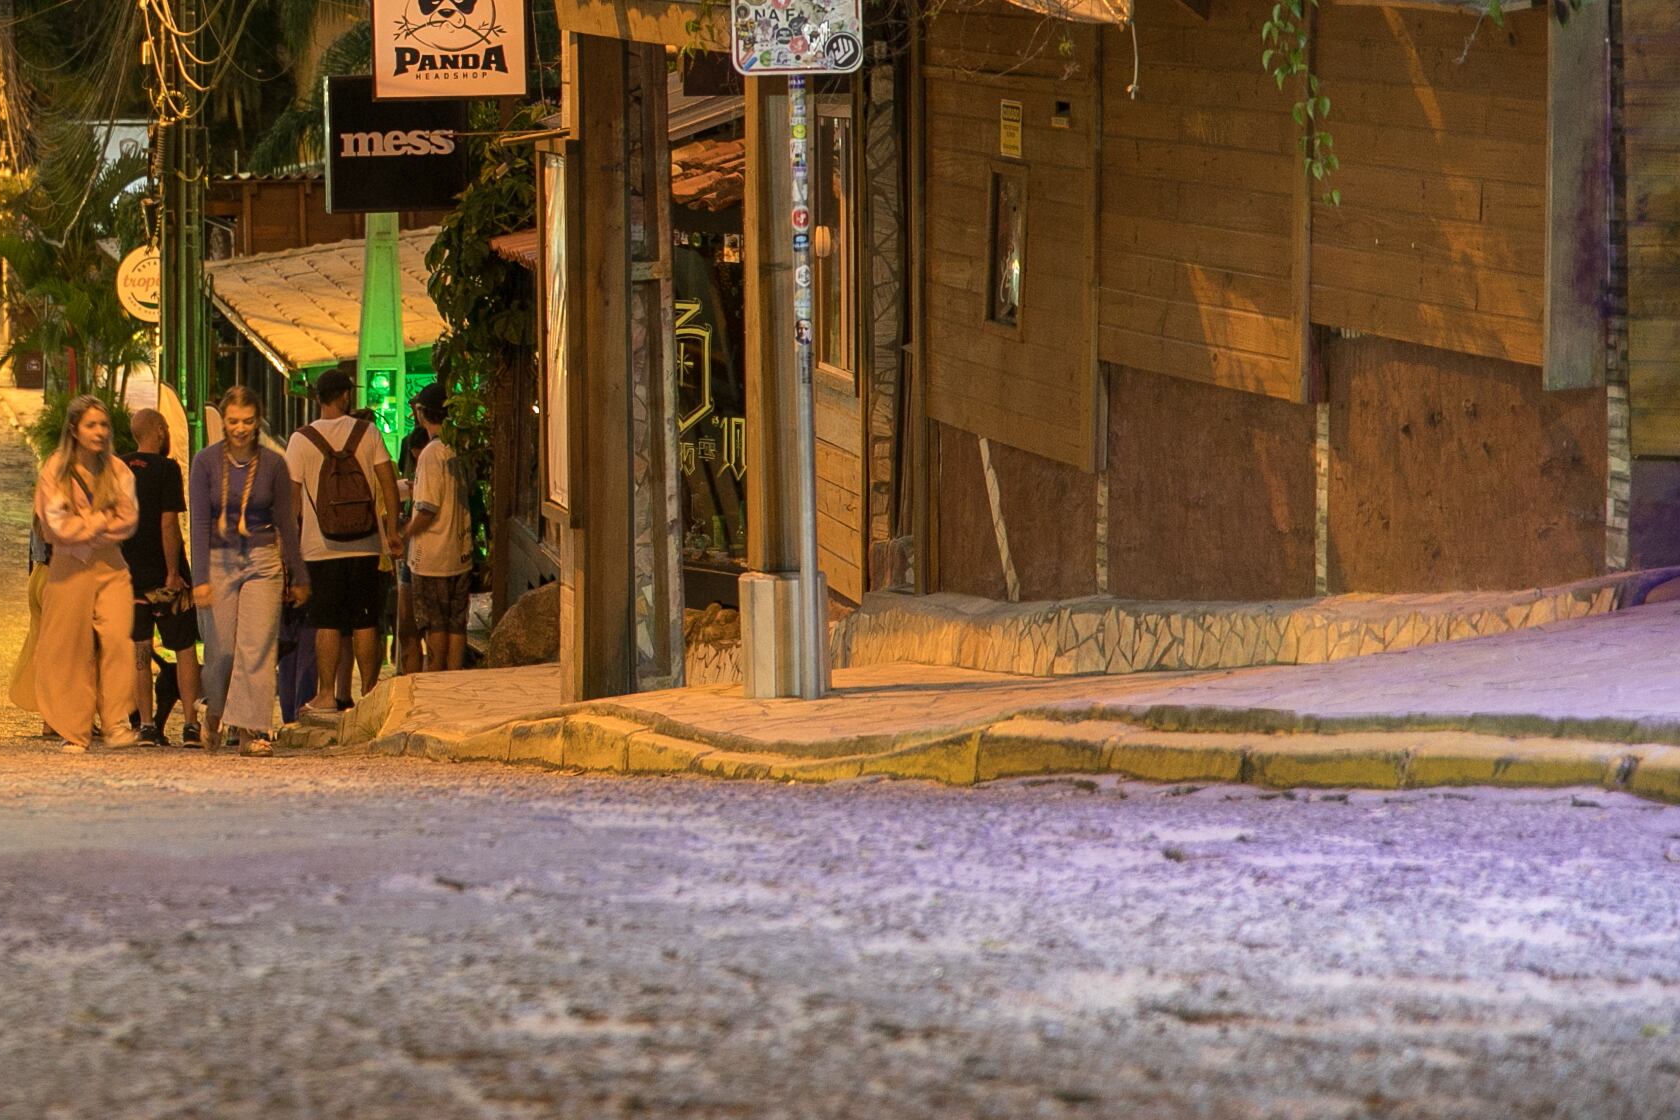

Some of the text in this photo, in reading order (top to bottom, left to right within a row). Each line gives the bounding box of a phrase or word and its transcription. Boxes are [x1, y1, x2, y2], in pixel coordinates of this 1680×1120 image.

[393, 44, 509, 77] PANDA
[415, 71, 488, 81] HEADSHOP
[340, 129, 456, 157] mess
